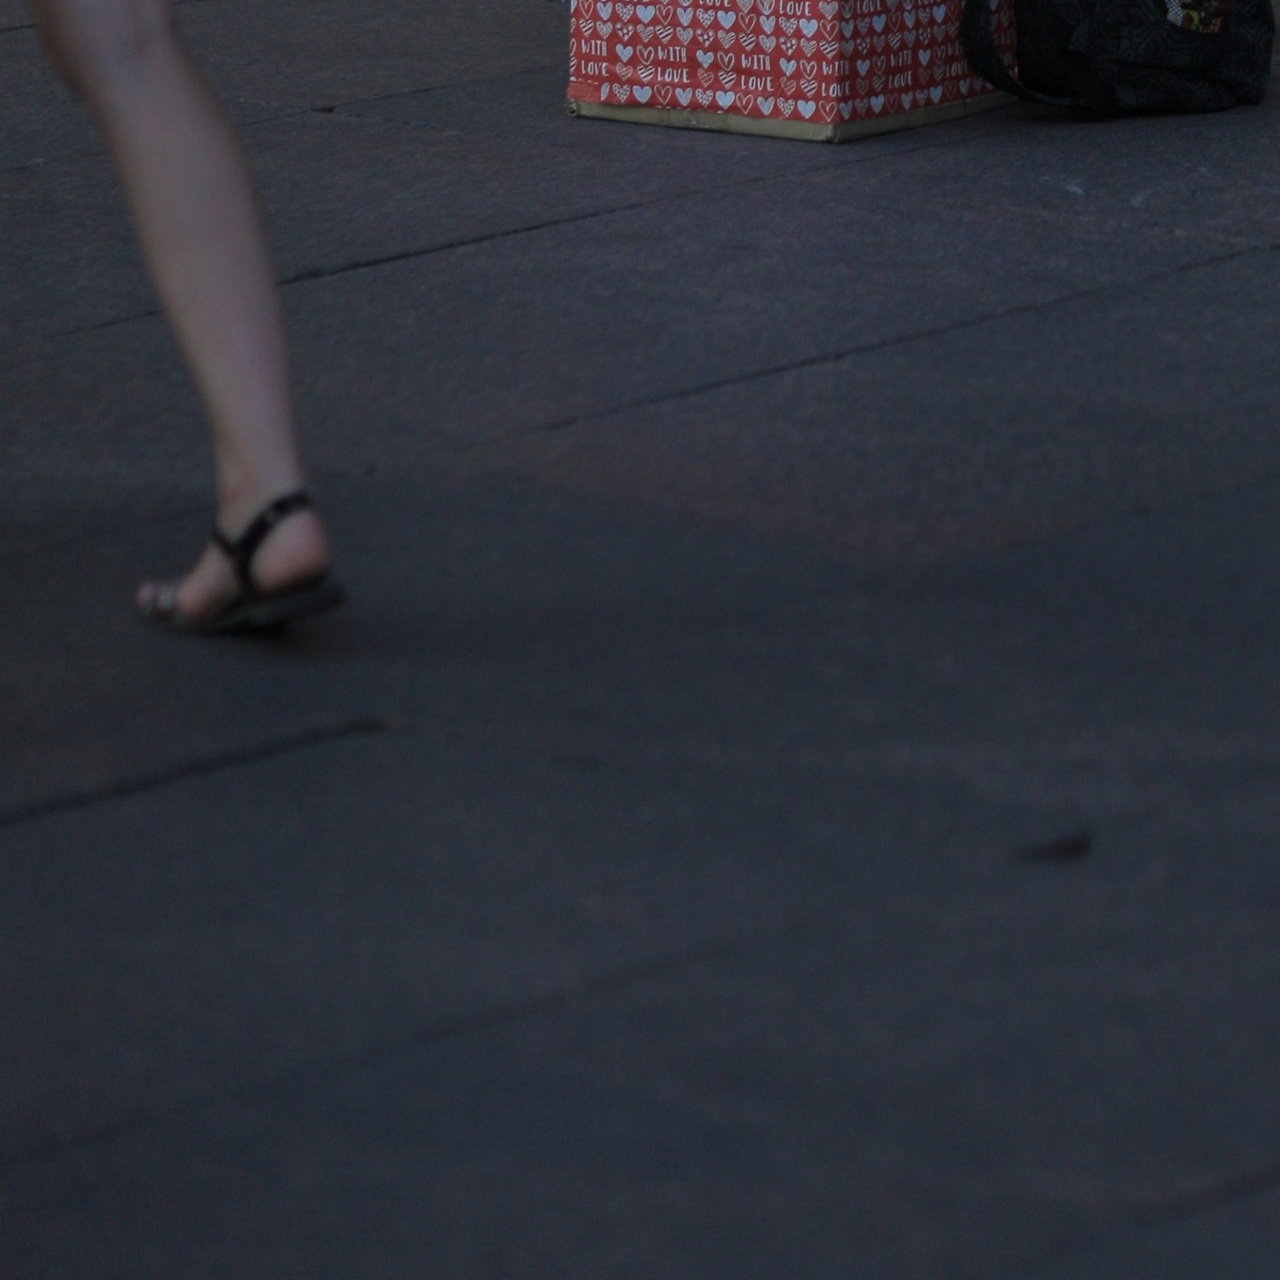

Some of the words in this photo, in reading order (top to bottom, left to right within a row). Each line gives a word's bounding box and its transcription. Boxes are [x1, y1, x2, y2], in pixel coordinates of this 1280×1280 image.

[779, 0, 811, 15] LOVE
[658, 46, 687, 62] WITH
[742, 54, 770, 71] WITH
[657, 68, 690, 83] LOVE
[741, 76, 774, 91] LOVE
